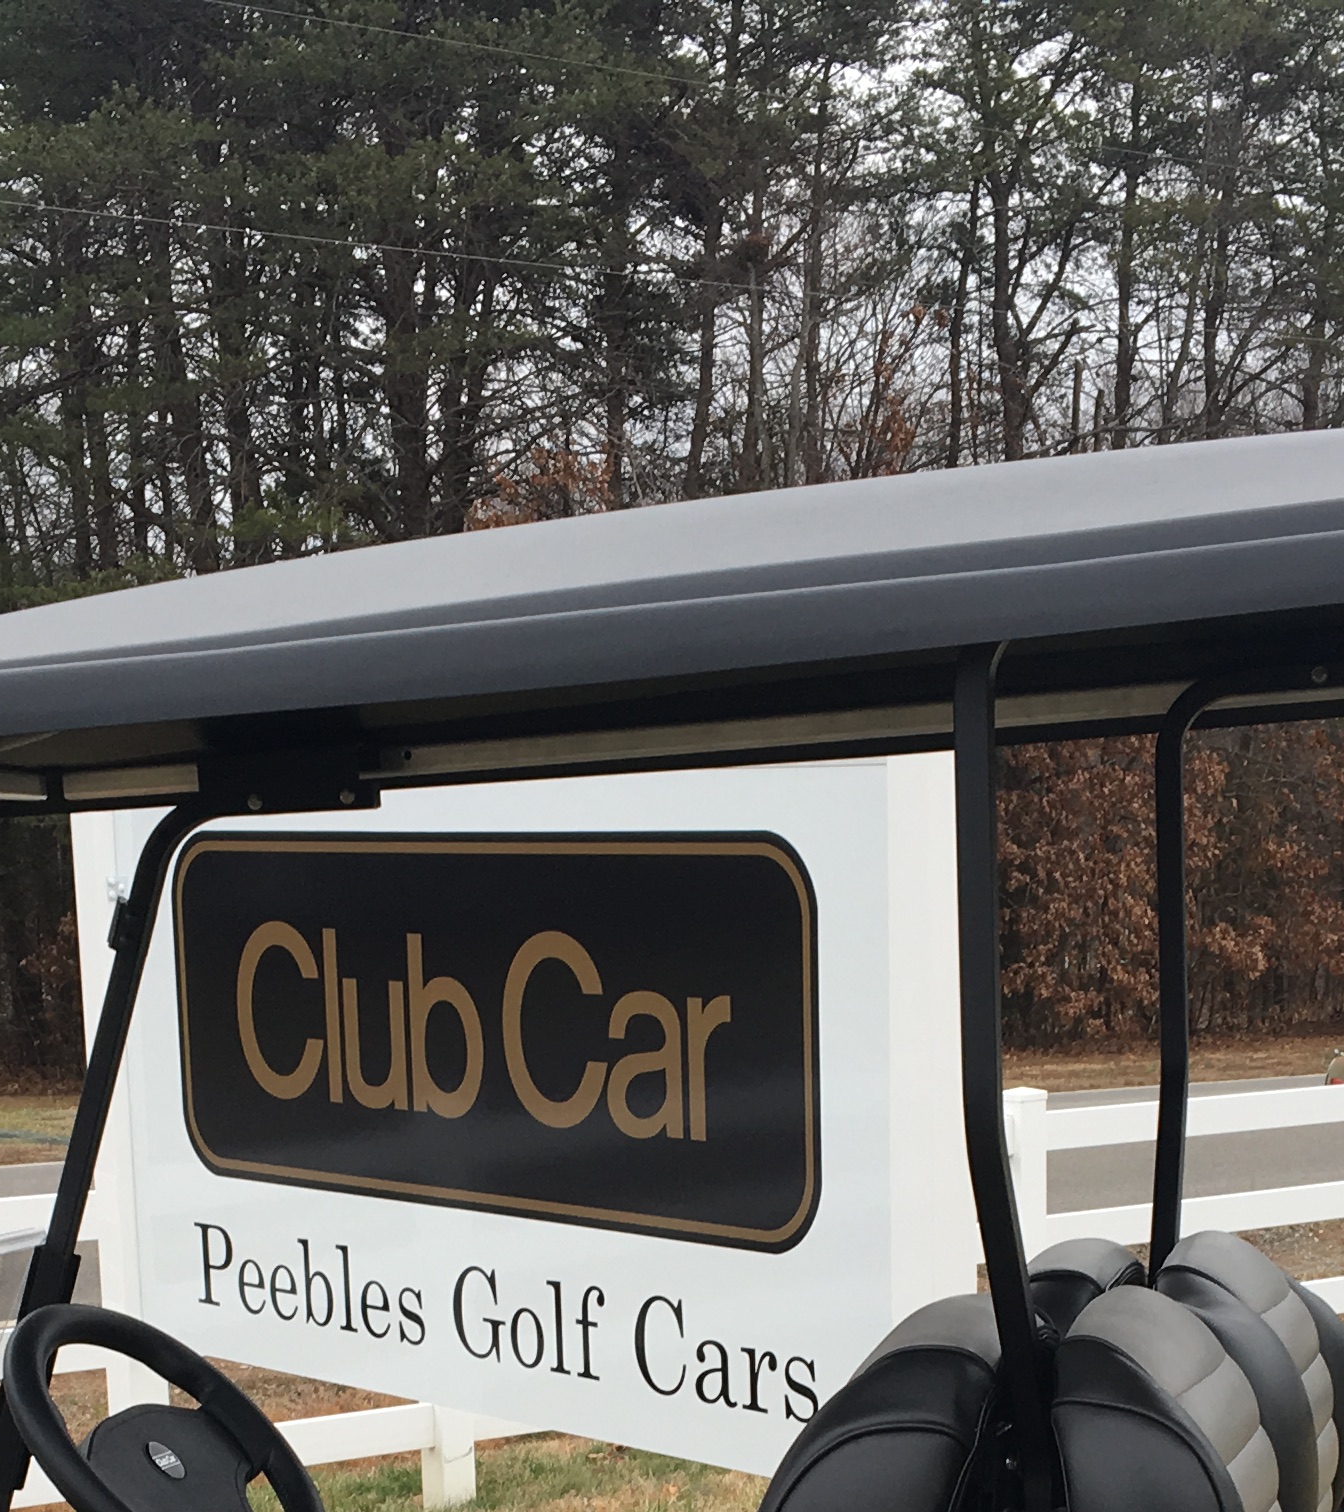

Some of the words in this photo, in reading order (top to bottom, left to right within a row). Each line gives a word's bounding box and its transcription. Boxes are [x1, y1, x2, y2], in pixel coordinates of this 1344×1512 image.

[236, 920, 484, 1119] Club
[502, 930, 731, 1142] Car
[193, 1222, 425, 1345] Peebles
[452, 1265, 605, 1380] Golf
[633, 1295, 818, 1423] Cars
